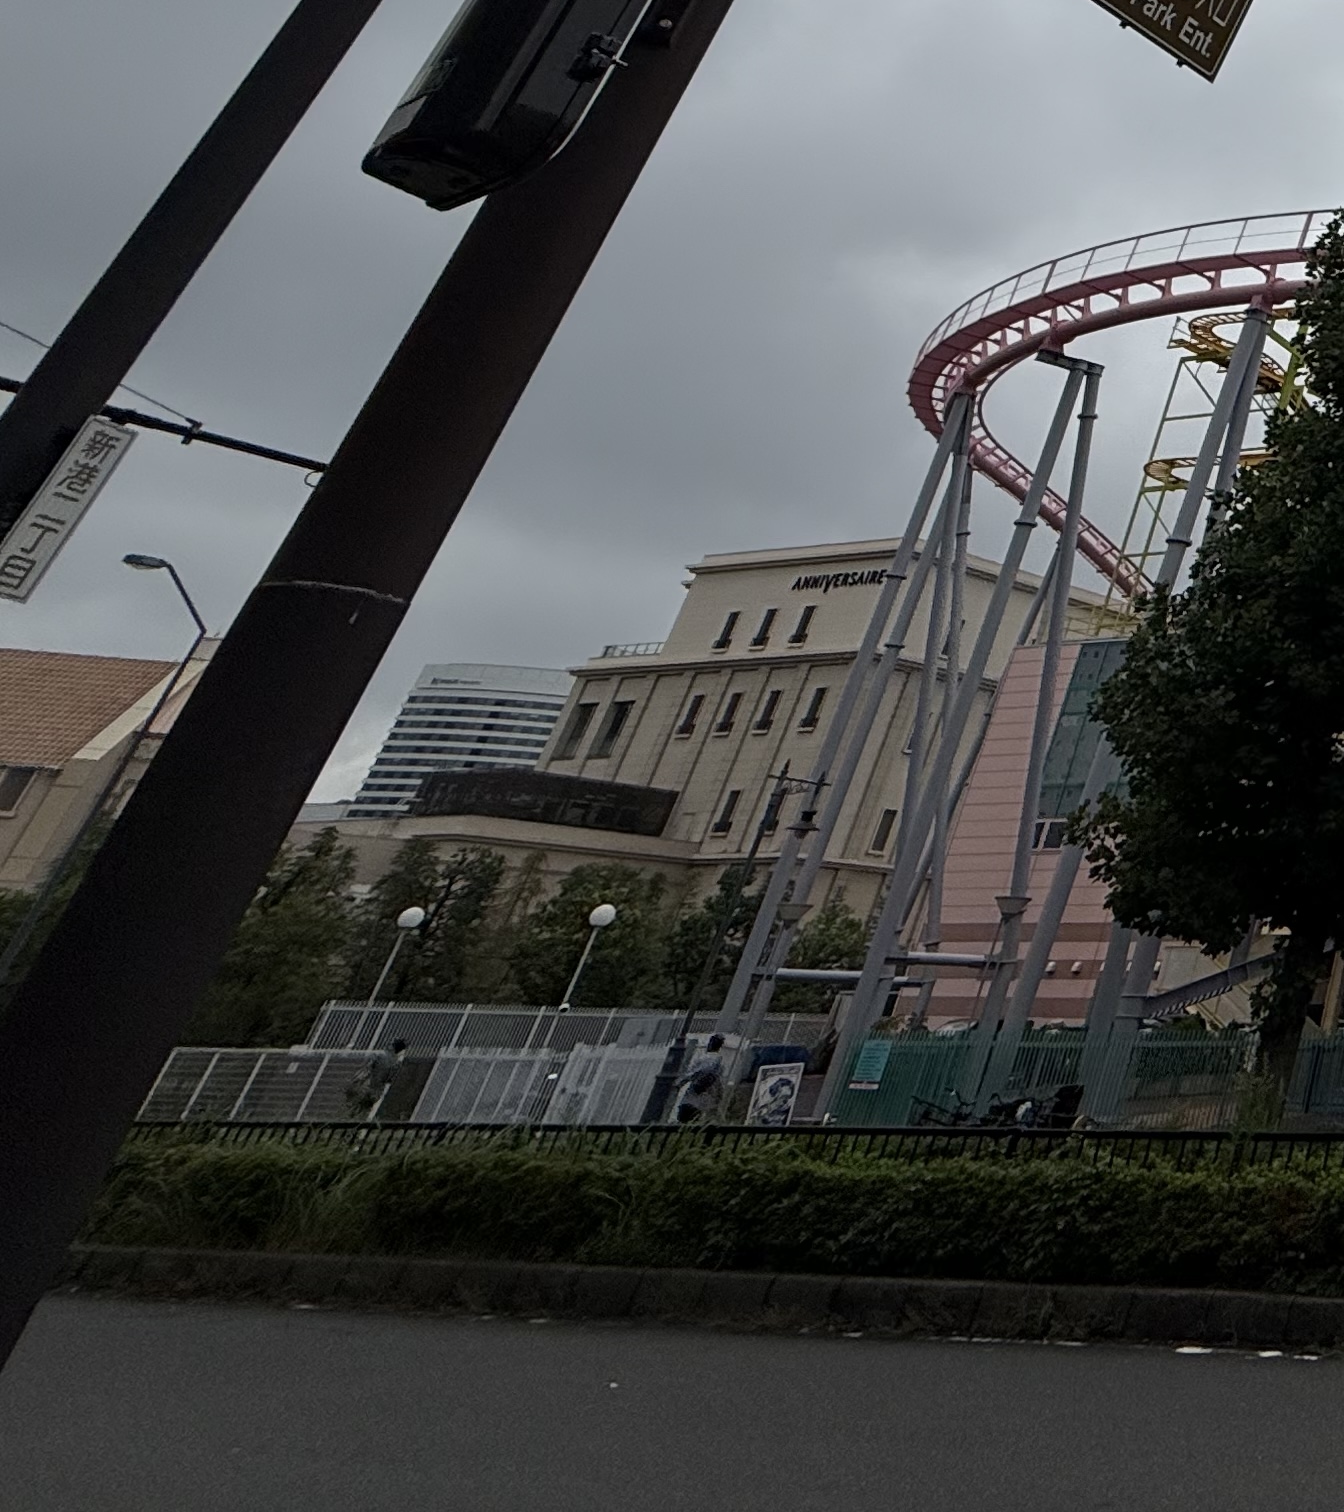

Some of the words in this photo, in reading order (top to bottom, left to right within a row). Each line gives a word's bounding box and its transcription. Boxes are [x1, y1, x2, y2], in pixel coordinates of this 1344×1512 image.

[1179, 17, 1214, 58] Ent.
[0, 430, 120, 588] 新港二丁目
[791, 569, 887, 593] ANNIVERSAIRE
